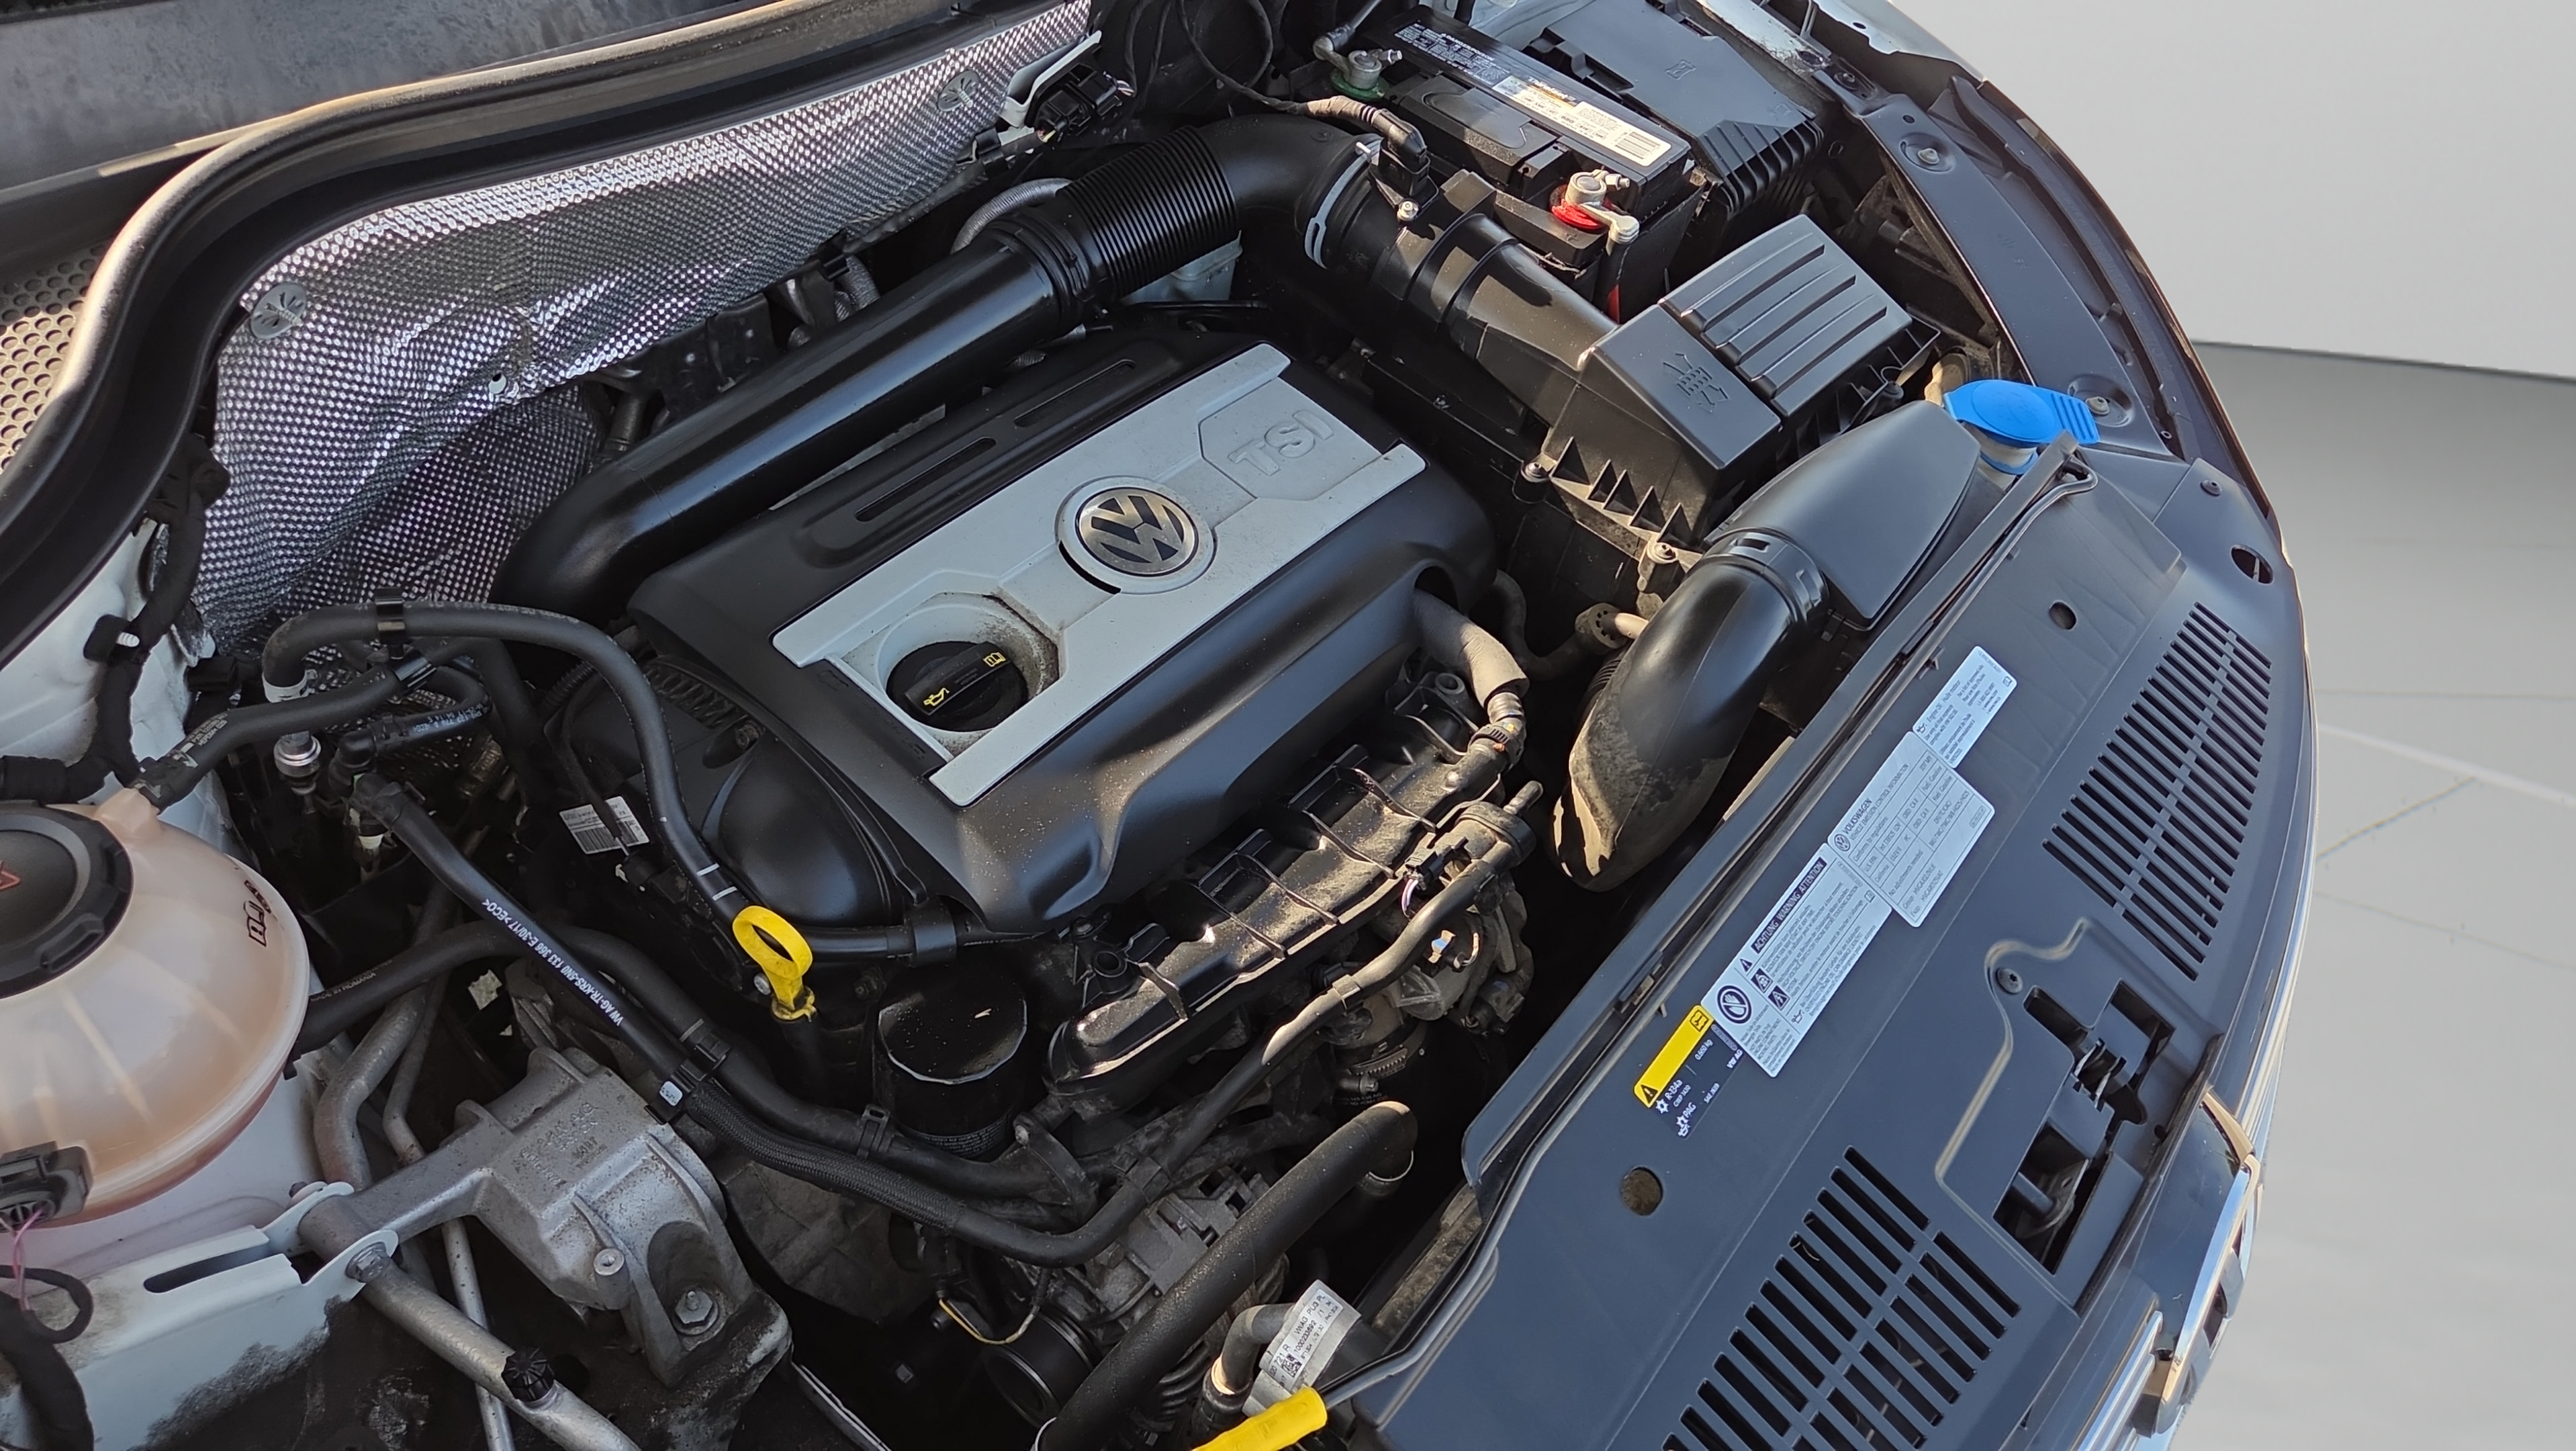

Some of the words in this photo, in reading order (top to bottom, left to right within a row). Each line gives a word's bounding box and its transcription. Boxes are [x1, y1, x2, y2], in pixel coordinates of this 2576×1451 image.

[1228, 410, 1334, 475] TSI
[1843, 798, 1872, 834] VOLKSWAGEN
[481, 897, 512, 925] >ECO<
[1755, 920, 1779, 950] ACHTUNG
[1776, 891, 1800, 920] WARNING
[1798, 861, 1823, 893] ATTENTION
[508, 920, 539, 947] E-30/17
[535, 940, 553, 958] 366
[547, 953, 565, 969] 133
[610, 1012, 625, 1026] VW
[1727, 1057, 1737, 1068] VW
[1734, 1049, 1743, 1059] AG
[1665, 1080, 1682, 1100] R-134a
[1682, 1102, 1696, 1118] PAG
[1273, 1352, 1285, 1366] 721
[1282, 1344, 1291, 1352] R
